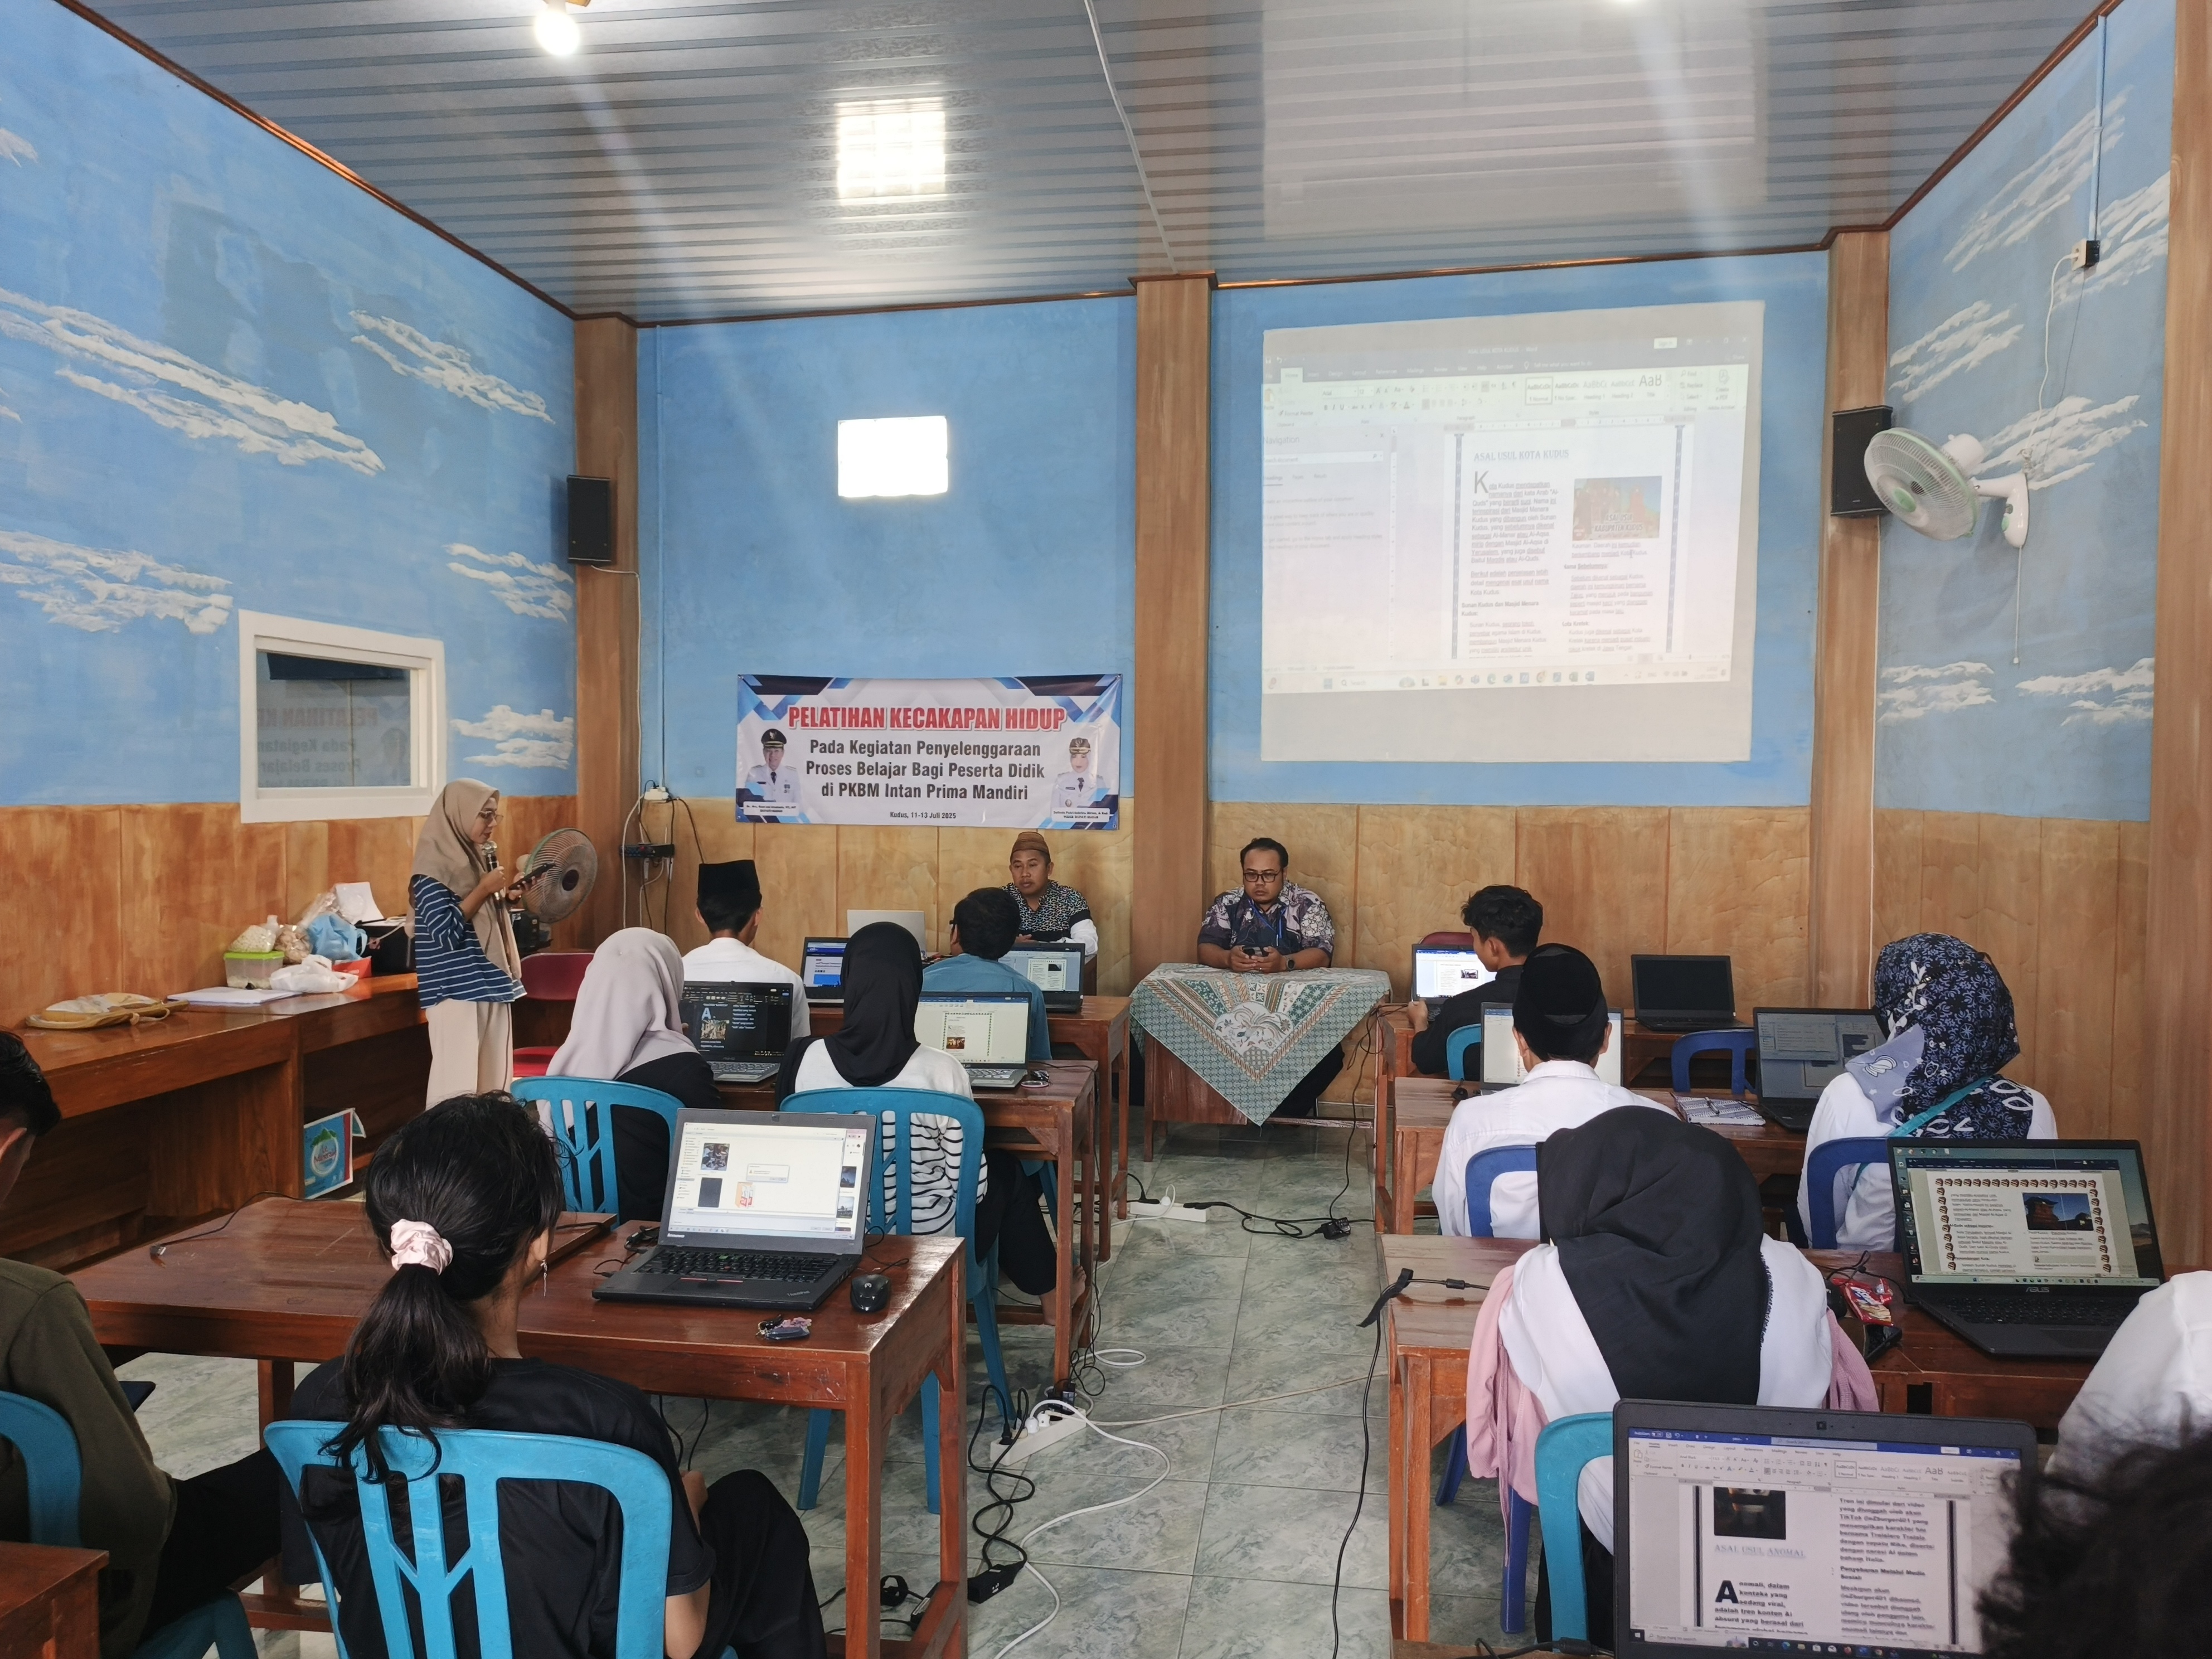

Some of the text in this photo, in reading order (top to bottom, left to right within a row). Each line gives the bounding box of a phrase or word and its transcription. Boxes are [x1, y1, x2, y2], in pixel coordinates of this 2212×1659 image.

[1474, 450, 1569, 462] ASAL USUL KOTA KUDUS
[788, 706, 1065, 730] PELATIHAN KECAKAPAN HIDUP
[810, 739, 1040, 759] Pada Kegiatan Penyelenggaraan
[806, 760, 1045, 780] Proses Belajar Bagi Peserta Didik
[822, 782, 1028, 800] di PKBM Intan Prima Mandiri
[1715, 1580, 1739, 1604] A
